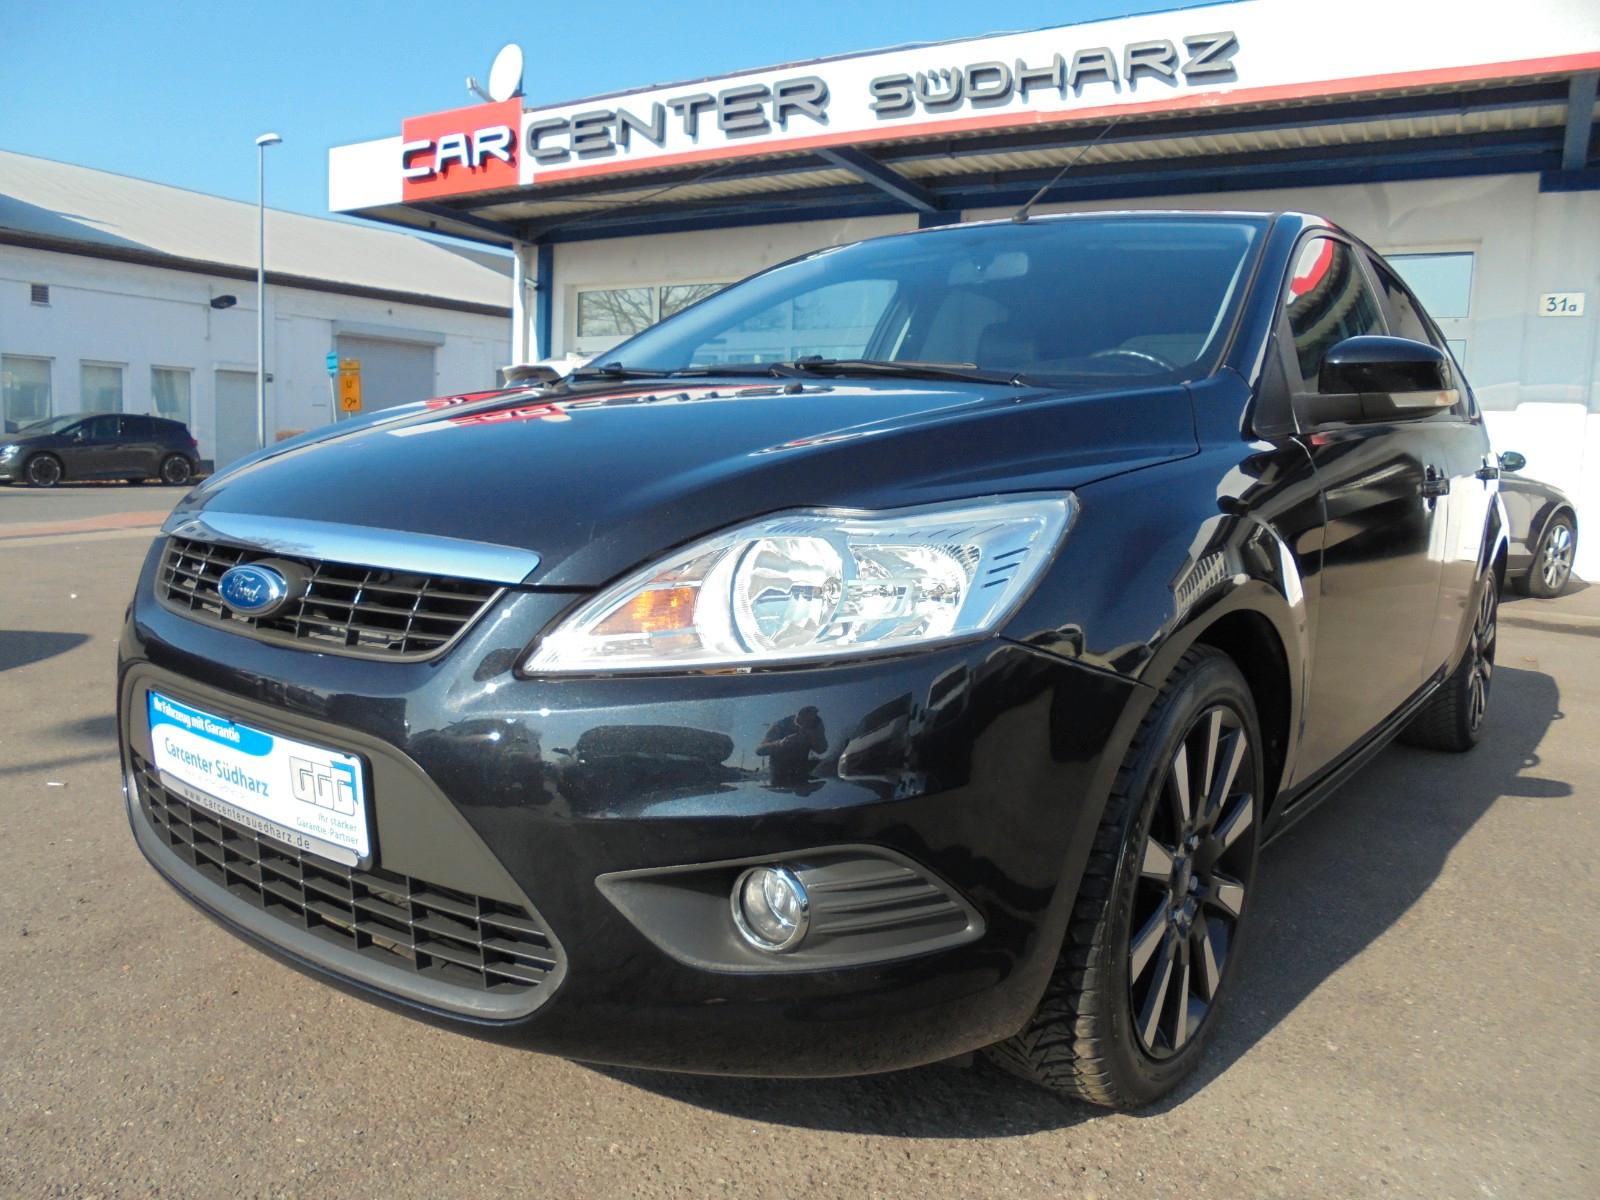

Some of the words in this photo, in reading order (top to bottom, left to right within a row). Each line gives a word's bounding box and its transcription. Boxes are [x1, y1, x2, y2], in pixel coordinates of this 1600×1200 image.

[869, 31, 1239, 116] SÜDHARZ
[1545, 296, 1577, 312] 31a
[162, 703, 191, 728] Fahrzeug
[191, 716, 204, 730] mit
[204, 719, 240, 743] Garantie
[165, 737, 213, 774] Carcenter
[215, 759, 269, 797] Südharz
[184, 787, 310, 850] www.carcentersuedharz.de
